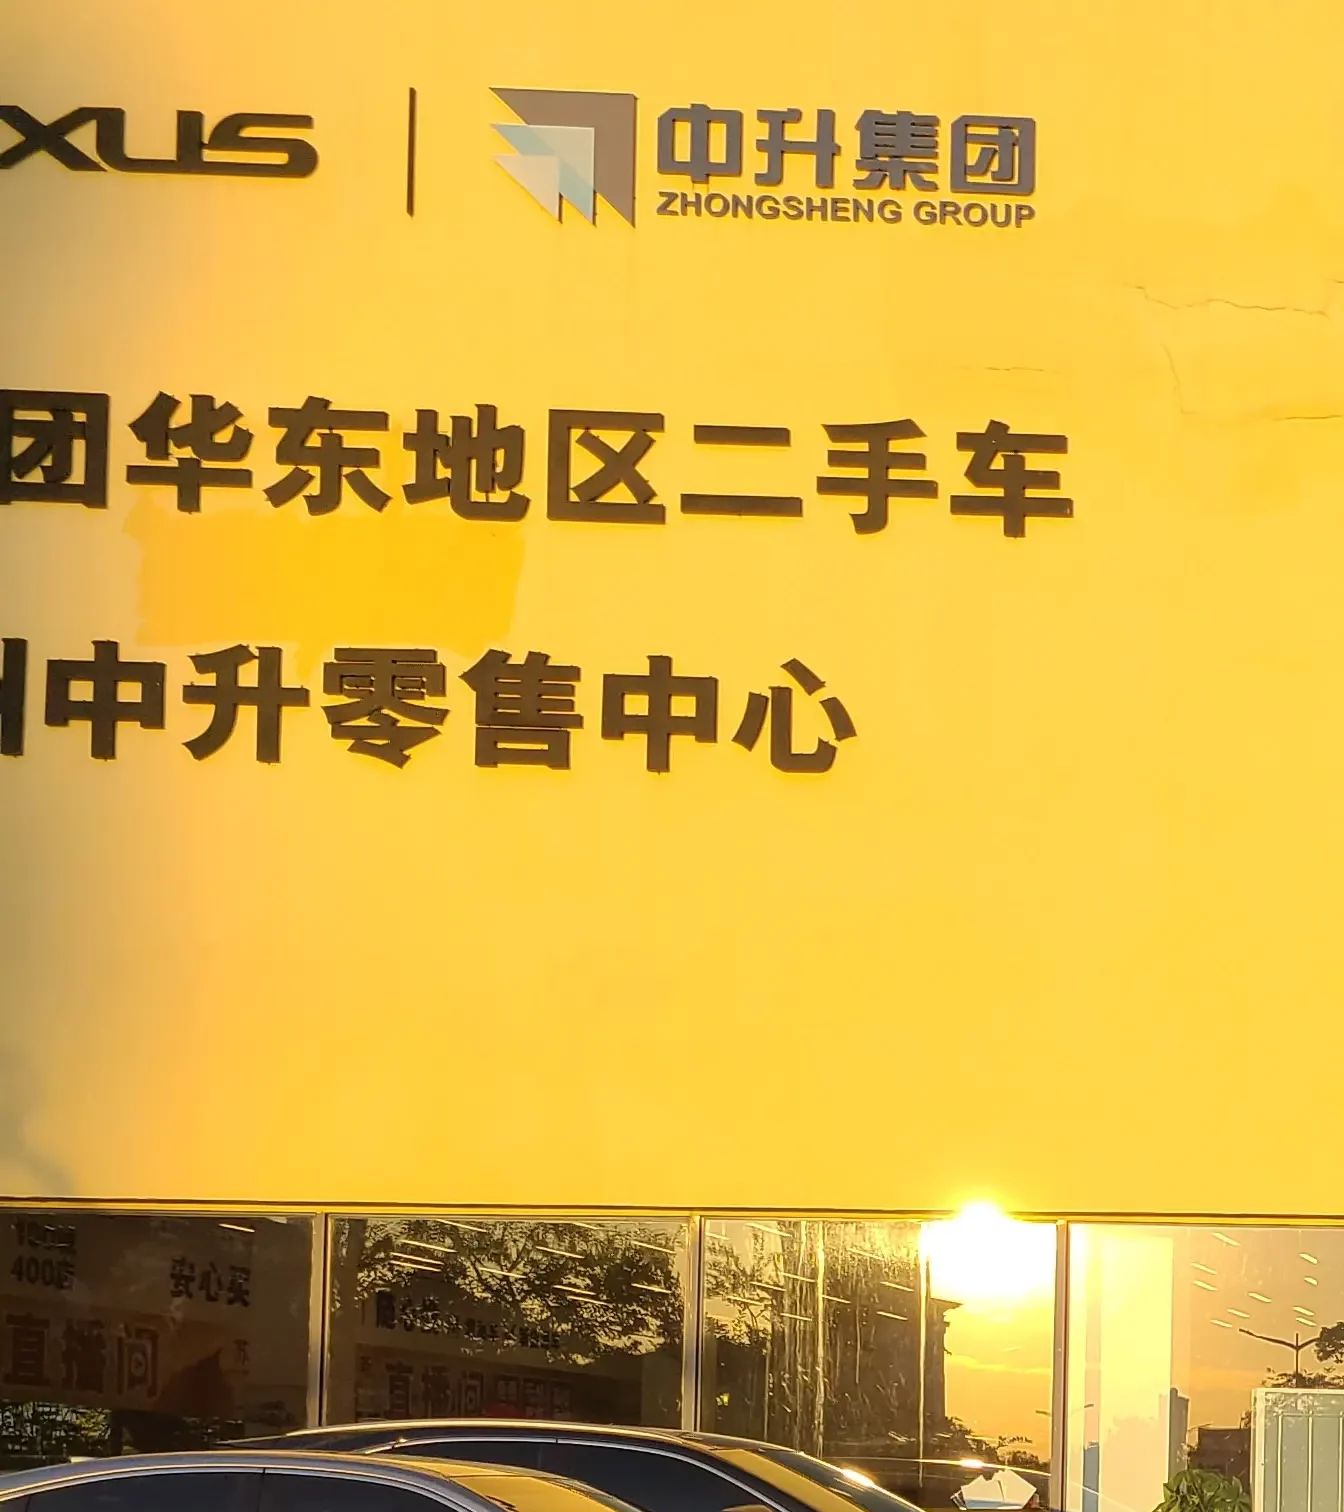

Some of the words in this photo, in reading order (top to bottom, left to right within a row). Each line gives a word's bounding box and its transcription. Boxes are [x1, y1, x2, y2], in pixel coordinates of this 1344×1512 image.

[0, 105, 318, 178] XUS
[656, 103, 1037, 197] 中升集团
[656, 191, 903, 225] ZHONGSHENG
[912, 201, 1036, 229] GROUP
[0, 388, 1074, 538] 团华东地区二手车
